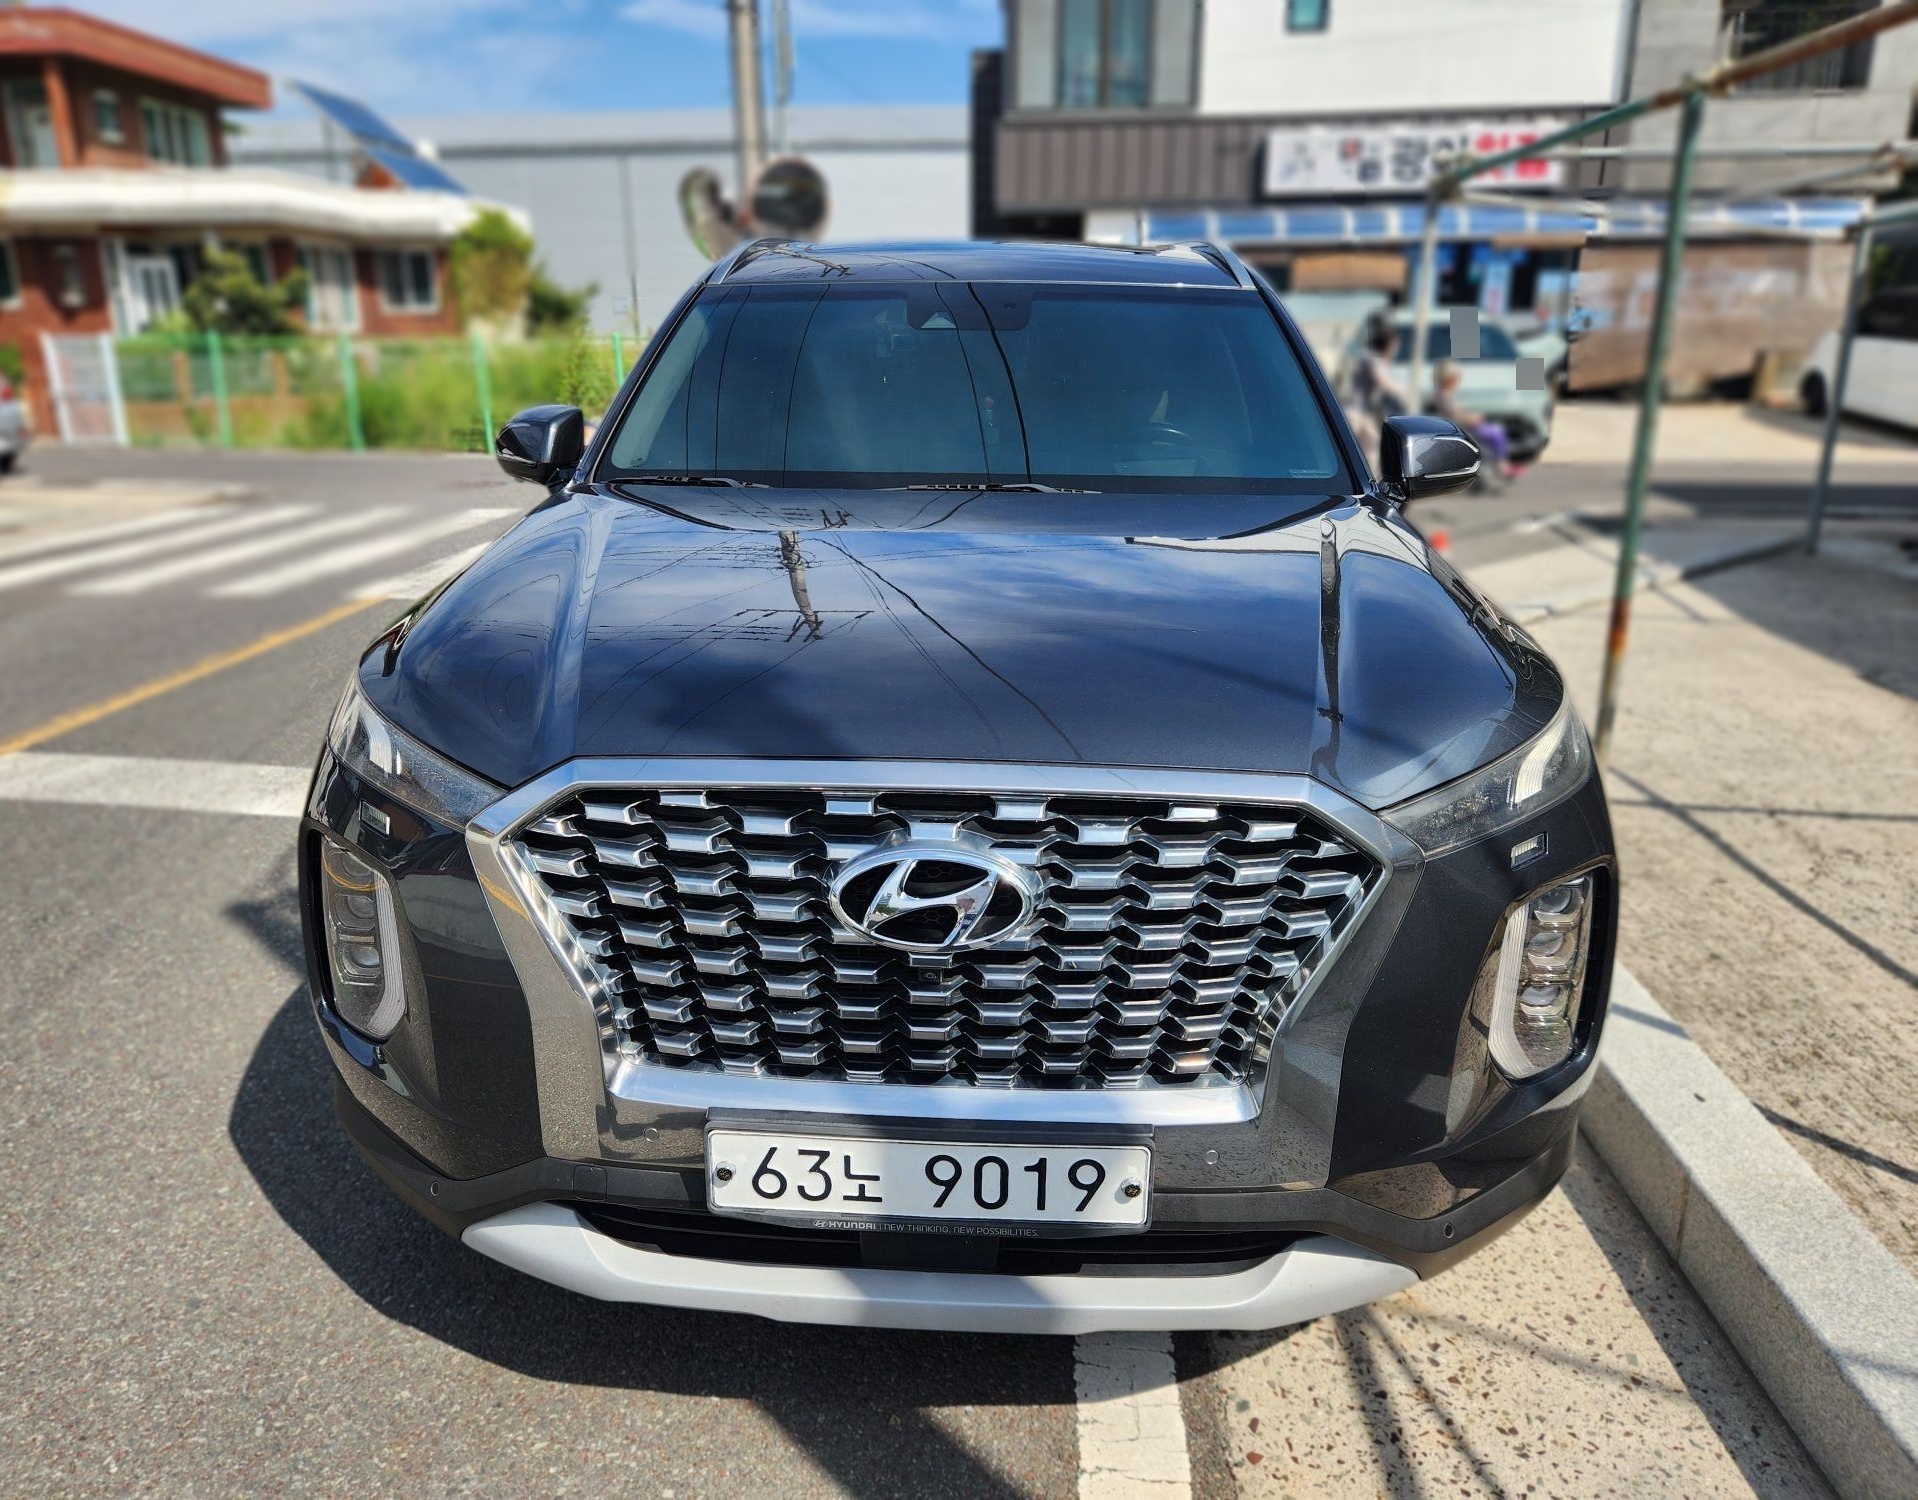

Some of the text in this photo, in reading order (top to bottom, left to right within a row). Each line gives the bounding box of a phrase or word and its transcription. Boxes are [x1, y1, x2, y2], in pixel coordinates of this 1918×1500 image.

[751, 1146, 1107, 1212] 63노 9019
[828, 1220, 876, 1231] HYUNDAI
[884, 1223, 905, 1232] NEW
[953, 1226, 975, 1235] NEW
